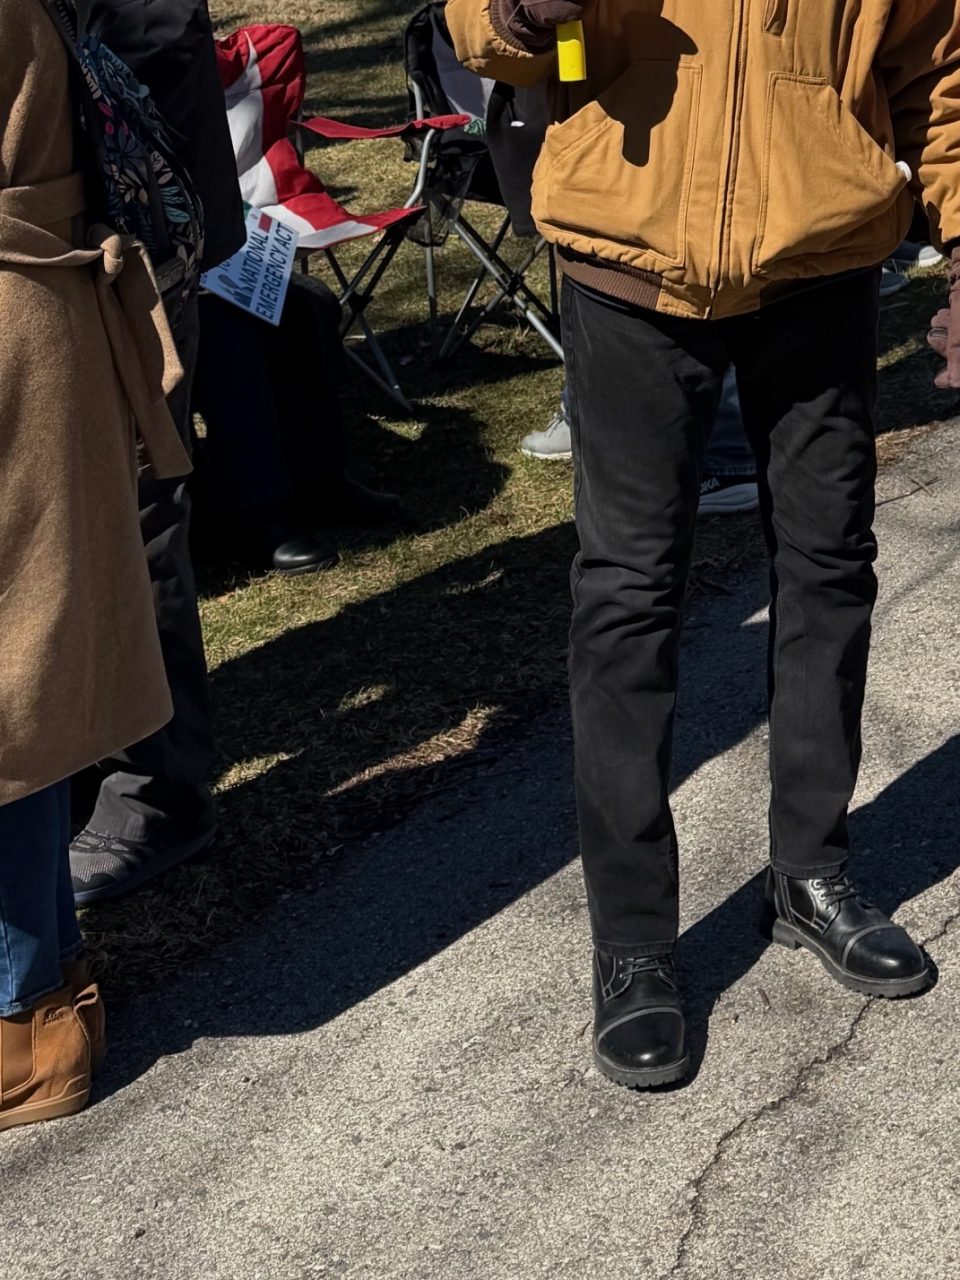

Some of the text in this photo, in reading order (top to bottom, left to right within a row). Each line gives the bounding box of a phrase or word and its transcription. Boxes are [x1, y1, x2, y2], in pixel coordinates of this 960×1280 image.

[238, 231, 269, 298] NATIONAL
[255, 222, 294, 320] EMERGENCY ACT
